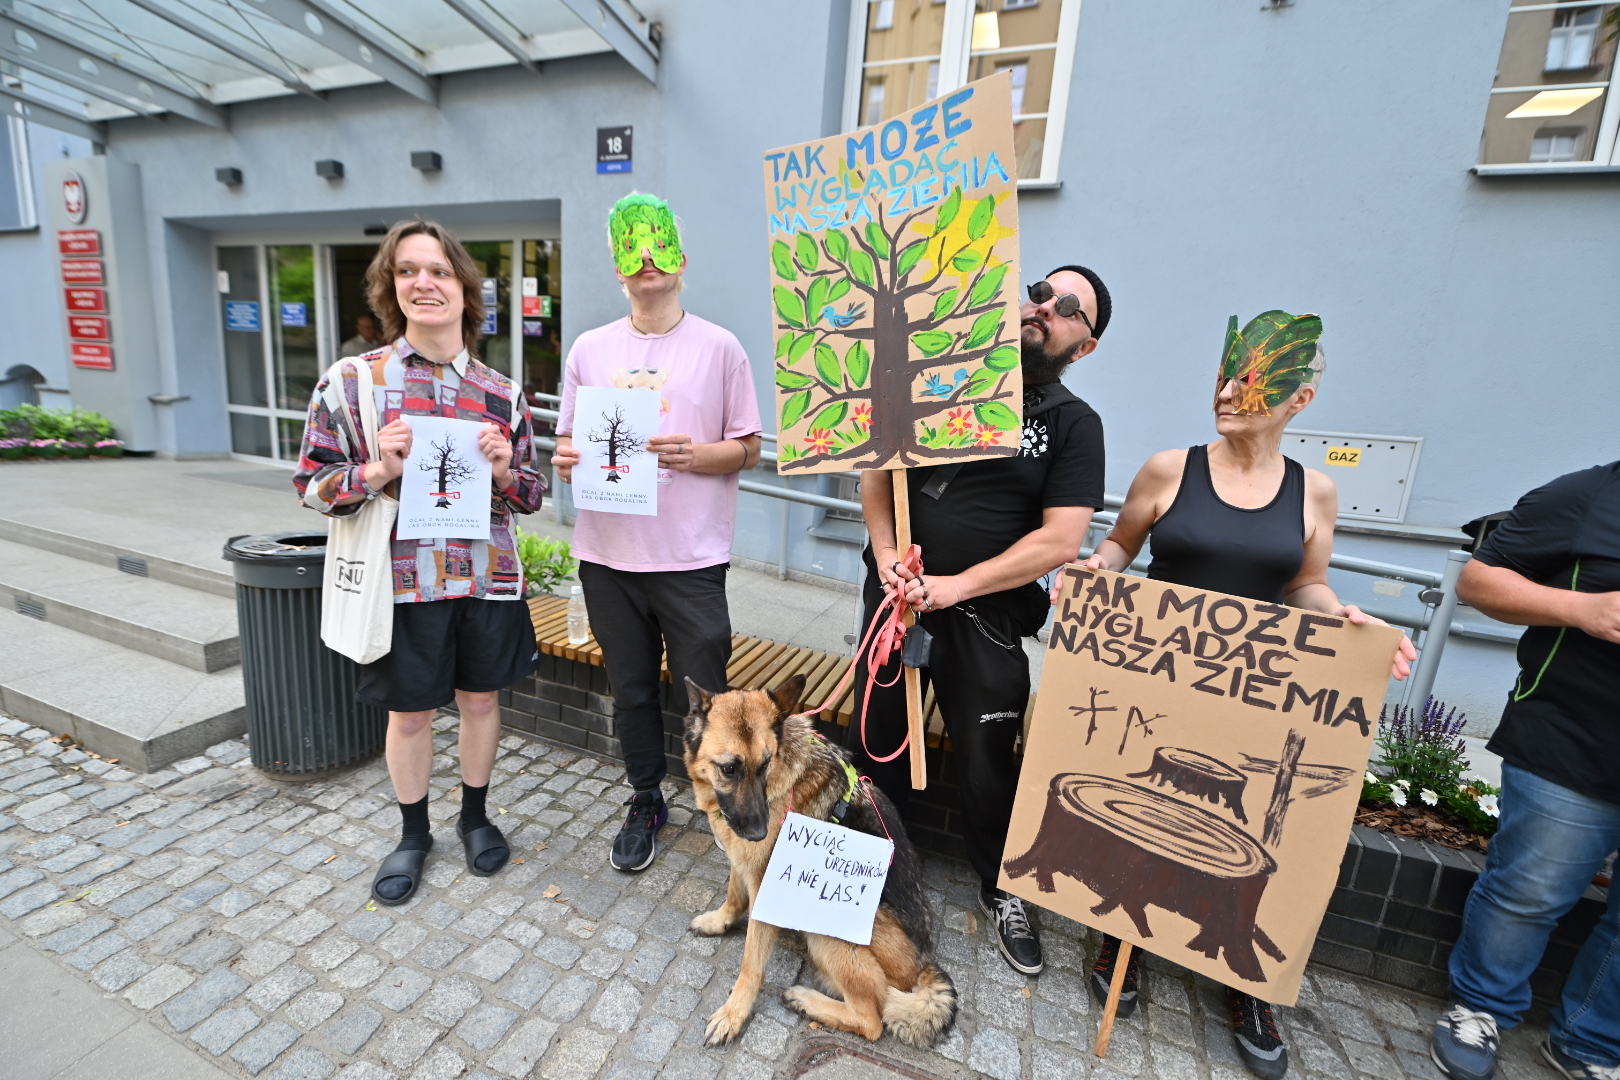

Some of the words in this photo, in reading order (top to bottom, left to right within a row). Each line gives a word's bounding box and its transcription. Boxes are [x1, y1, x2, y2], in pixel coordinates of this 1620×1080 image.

[606, 136, 623, 154] 18
[765, 145, 826, 182] TAK
[769, 197, 875, 237] NASZA
[886, 151, 1010, 218] ZIEMIA
[1021, 418, 1047, 434] ILD
[1328, 451, 1359, 463] GAZ
[1065, 568, 1141, 613] TAK
[1049, 621, 1176, 682] NASZA
[1190, 660, 1372, 737] ZIEMIA
[779, 864, 792, 882] A
